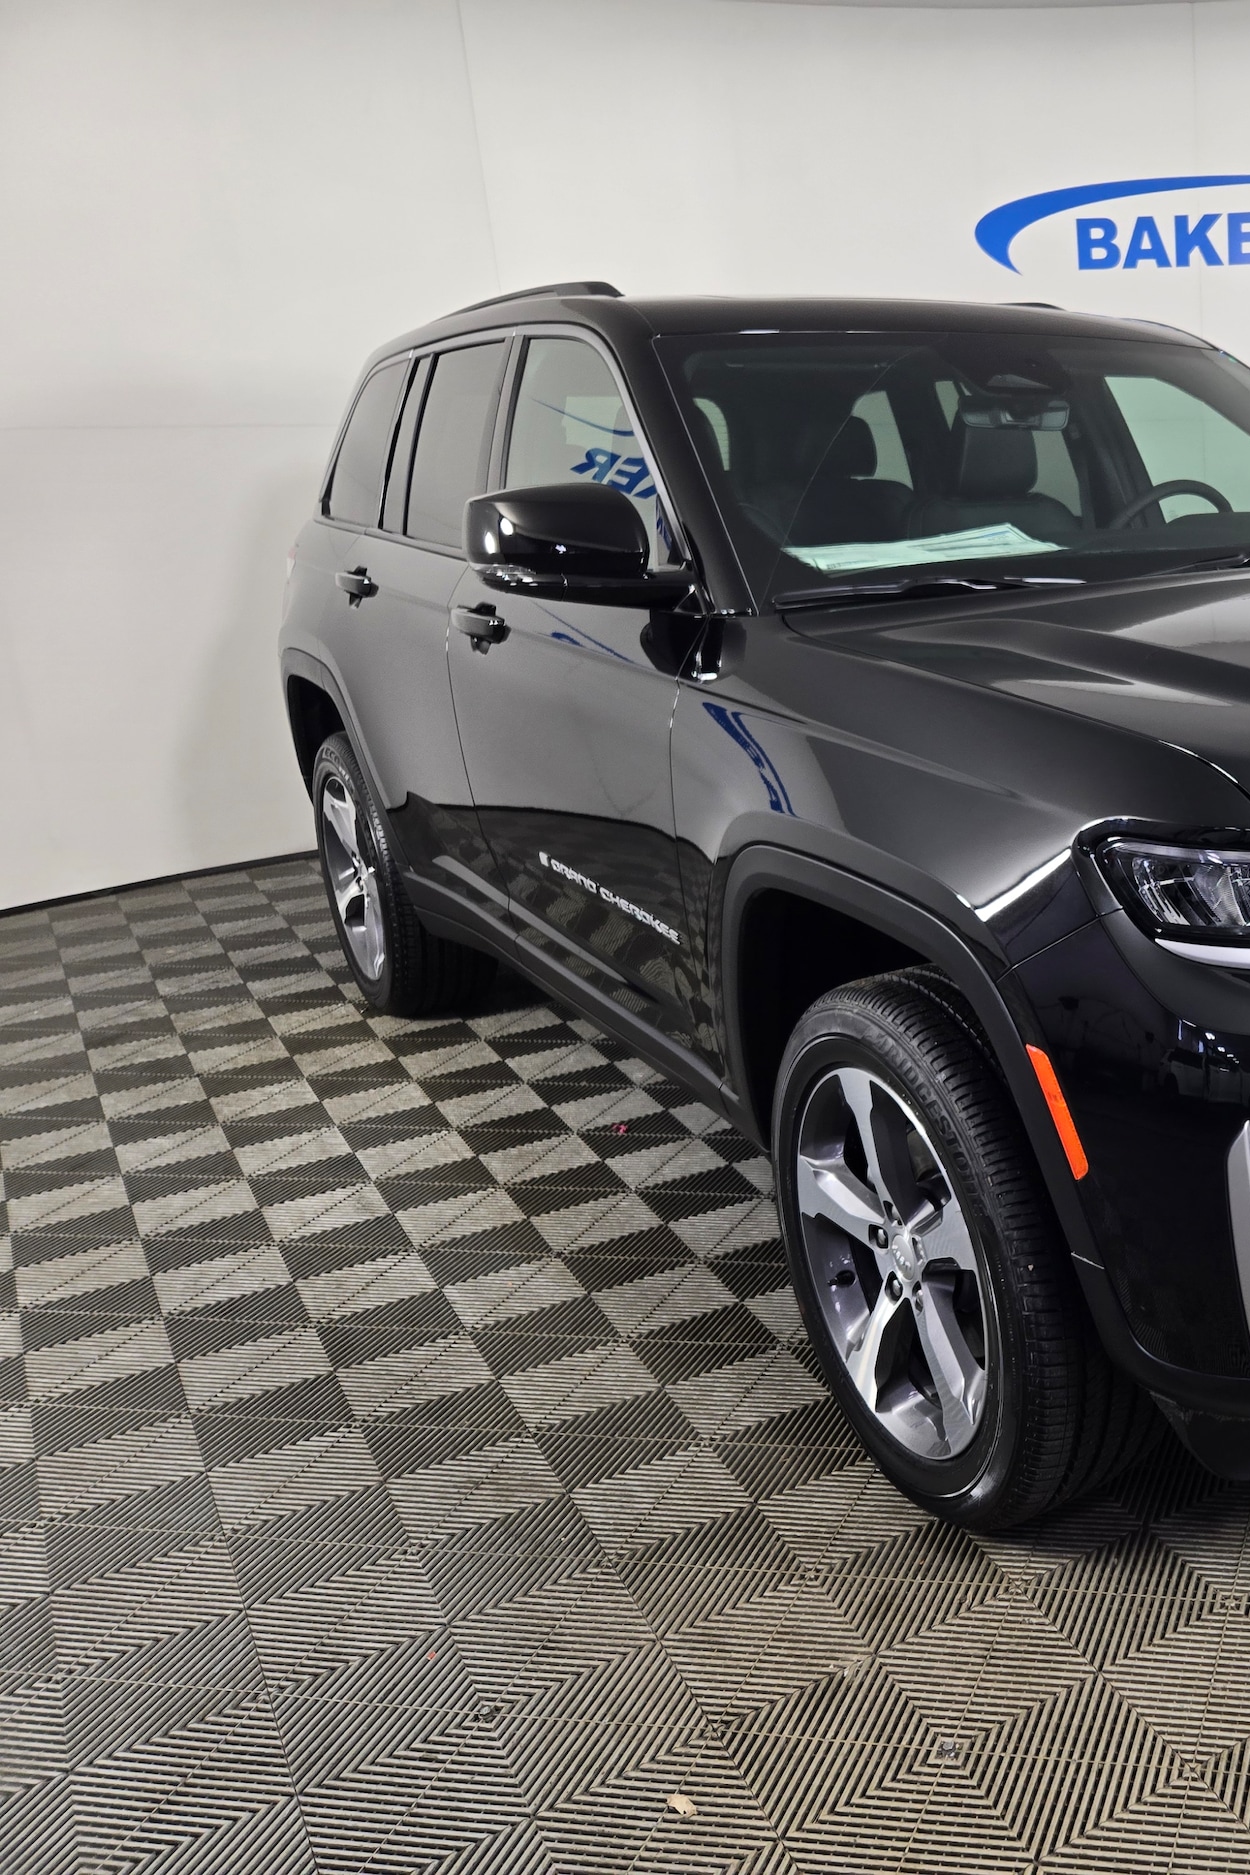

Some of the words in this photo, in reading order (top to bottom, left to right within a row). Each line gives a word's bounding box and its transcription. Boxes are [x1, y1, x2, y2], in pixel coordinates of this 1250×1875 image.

[550, 859, 598, 894] GRAND
[600, 887, 682, 945] CHEROKEE
[863, 1028, 985, 1217] BRIDGESTO
